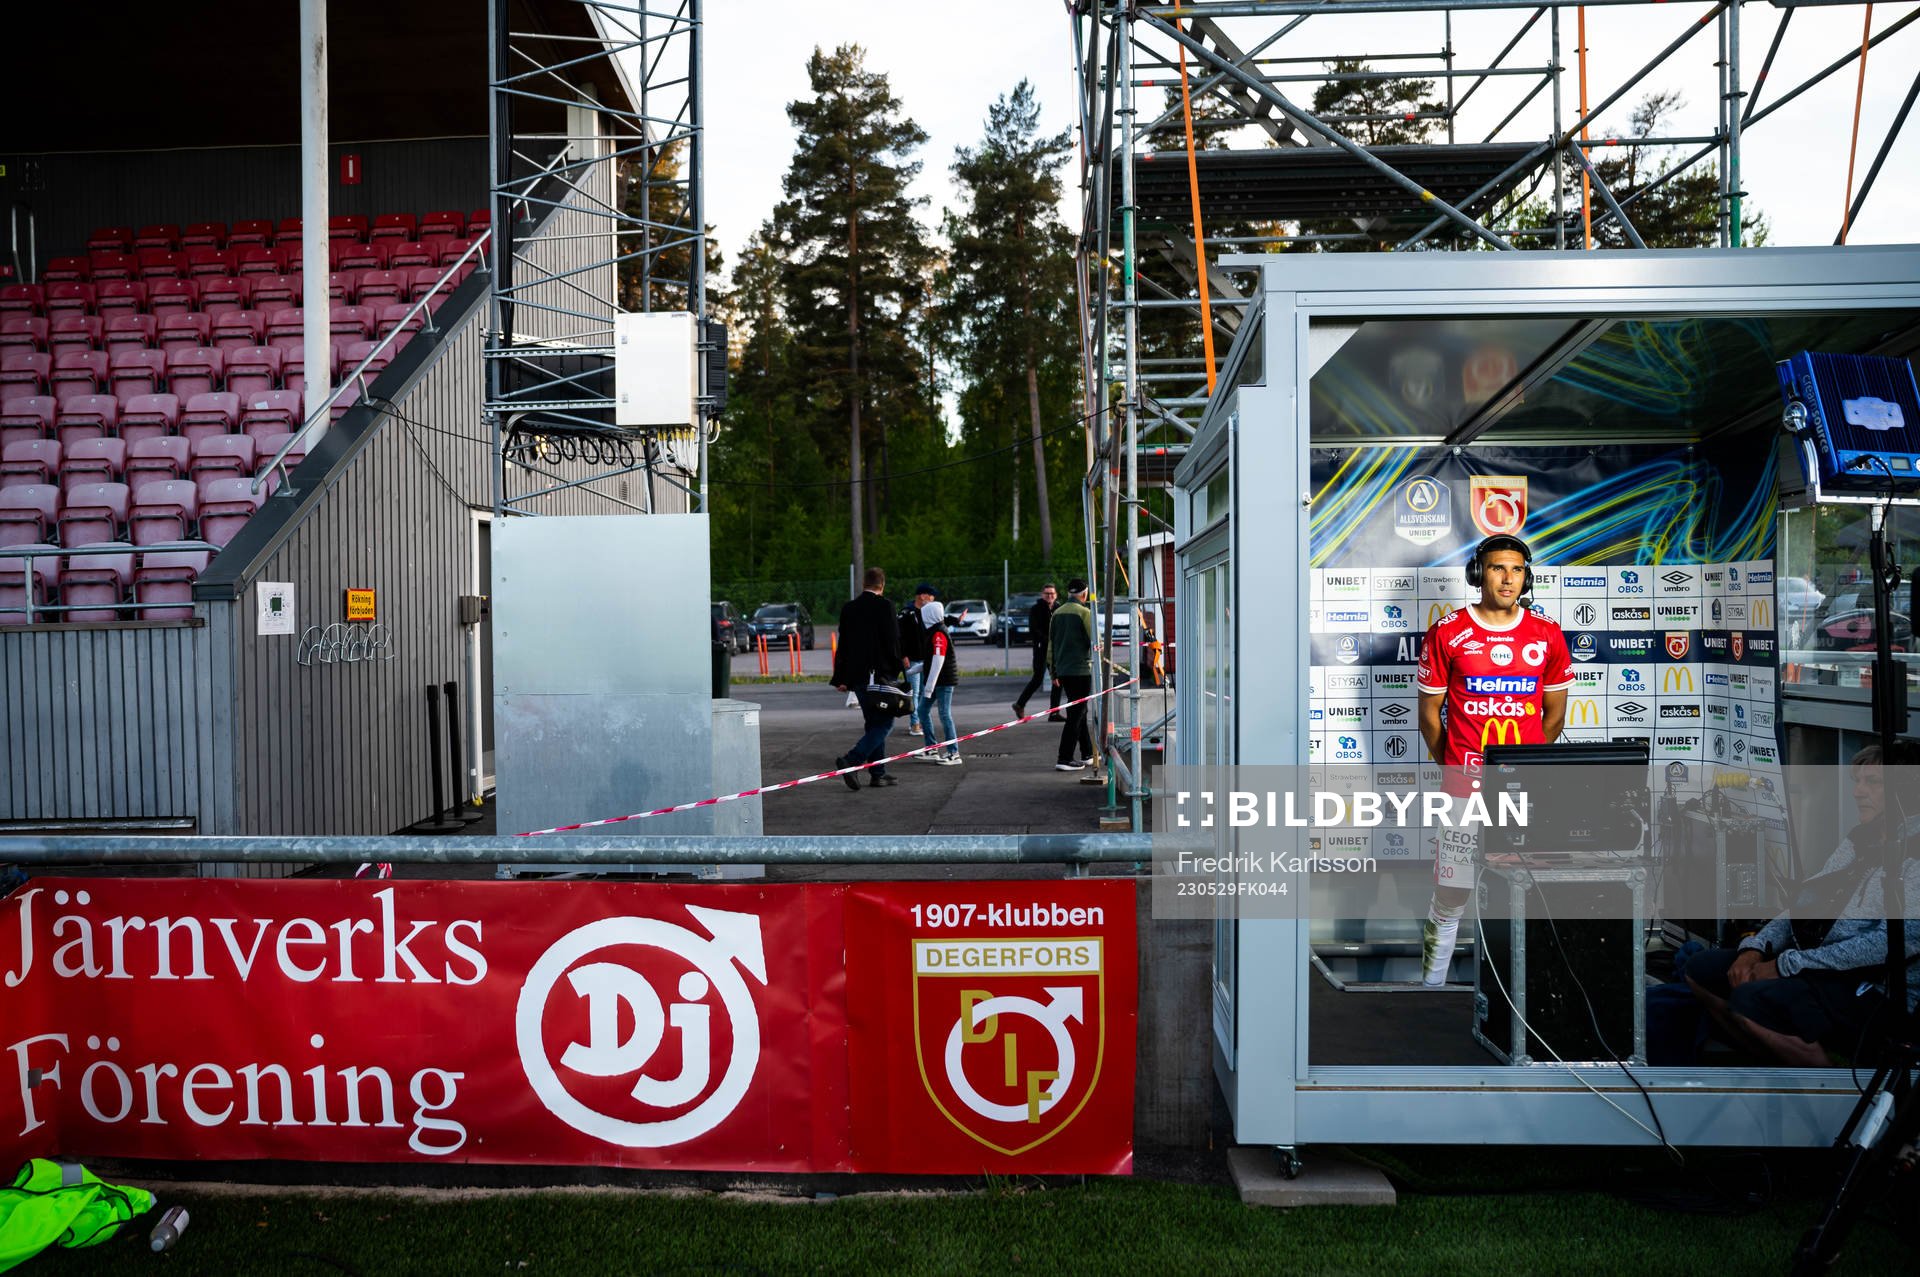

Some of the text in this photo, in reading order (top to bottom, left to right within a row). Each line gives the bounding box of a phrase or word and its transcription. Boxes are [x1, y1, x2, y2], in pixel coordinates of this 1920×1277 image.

[1399, 513, 1446, 524] ALLSVENSKAN
[1327, 576, 1367, 585] UNIBET
[1424, 576, 1461, 584] Strawberry
[1564, 577, 1606, 586] Helmia
[1705, 572, 1723, 581] UNIBET
[1748, 573, 1772, 582] Helmia
[1575, 605, 1594, 624] MG
[1613, 609, 1643, 620] askås
[1657, 606, 1699, 615] UNIBET
[1327, 612, 1368, 622] Helmia
[1437, 611, 1458, 627] AVIS
[1381, 620, 1408, 628] OBOS
[1609, 638, 1654, 649] UNIBET
[1704, 638, 1727, 648] UNIBET
[1748, 639, 1774, 651] UNIBET
[1375, 674, 1415, 683] UNIBET
[1730, 673, 1748, 685] UNIBET
[1466, 677, 1537, 693] Helmia
[1618, 684, 1645, 692] OBOS
[1329, 707, 1368, 716] UNIBET
[1463, 696, 1526, 717] askås
[1661, 706, 1693, 717] askås
[1707, 704, 1728, 716] UNIBET
[1617, 715, 1644, 723] umbro
[1386, 737, 1406, 756] MG
[1657, 736, 1700, 746] UNIBET
[1336, 751, 1363, 759] OBOS
[1749, 745, 1777, 758] UNIBET
[1329, 772, 1368, 782] Strawberry
[1378, 774, 1408, 785] askås
[1329, 836, 1369, 846] UNIBET
[1383, 848, 1410, 856] OBOS
[1440, 865, 1454, 879] 20
[911, 902, 1105, 928] 1907-klubben
[4, 886, 488, 988] Järnverks
[926, 946, 1091, 968] DEGERFORS
[6, 1033, 467, 1156] Förening
